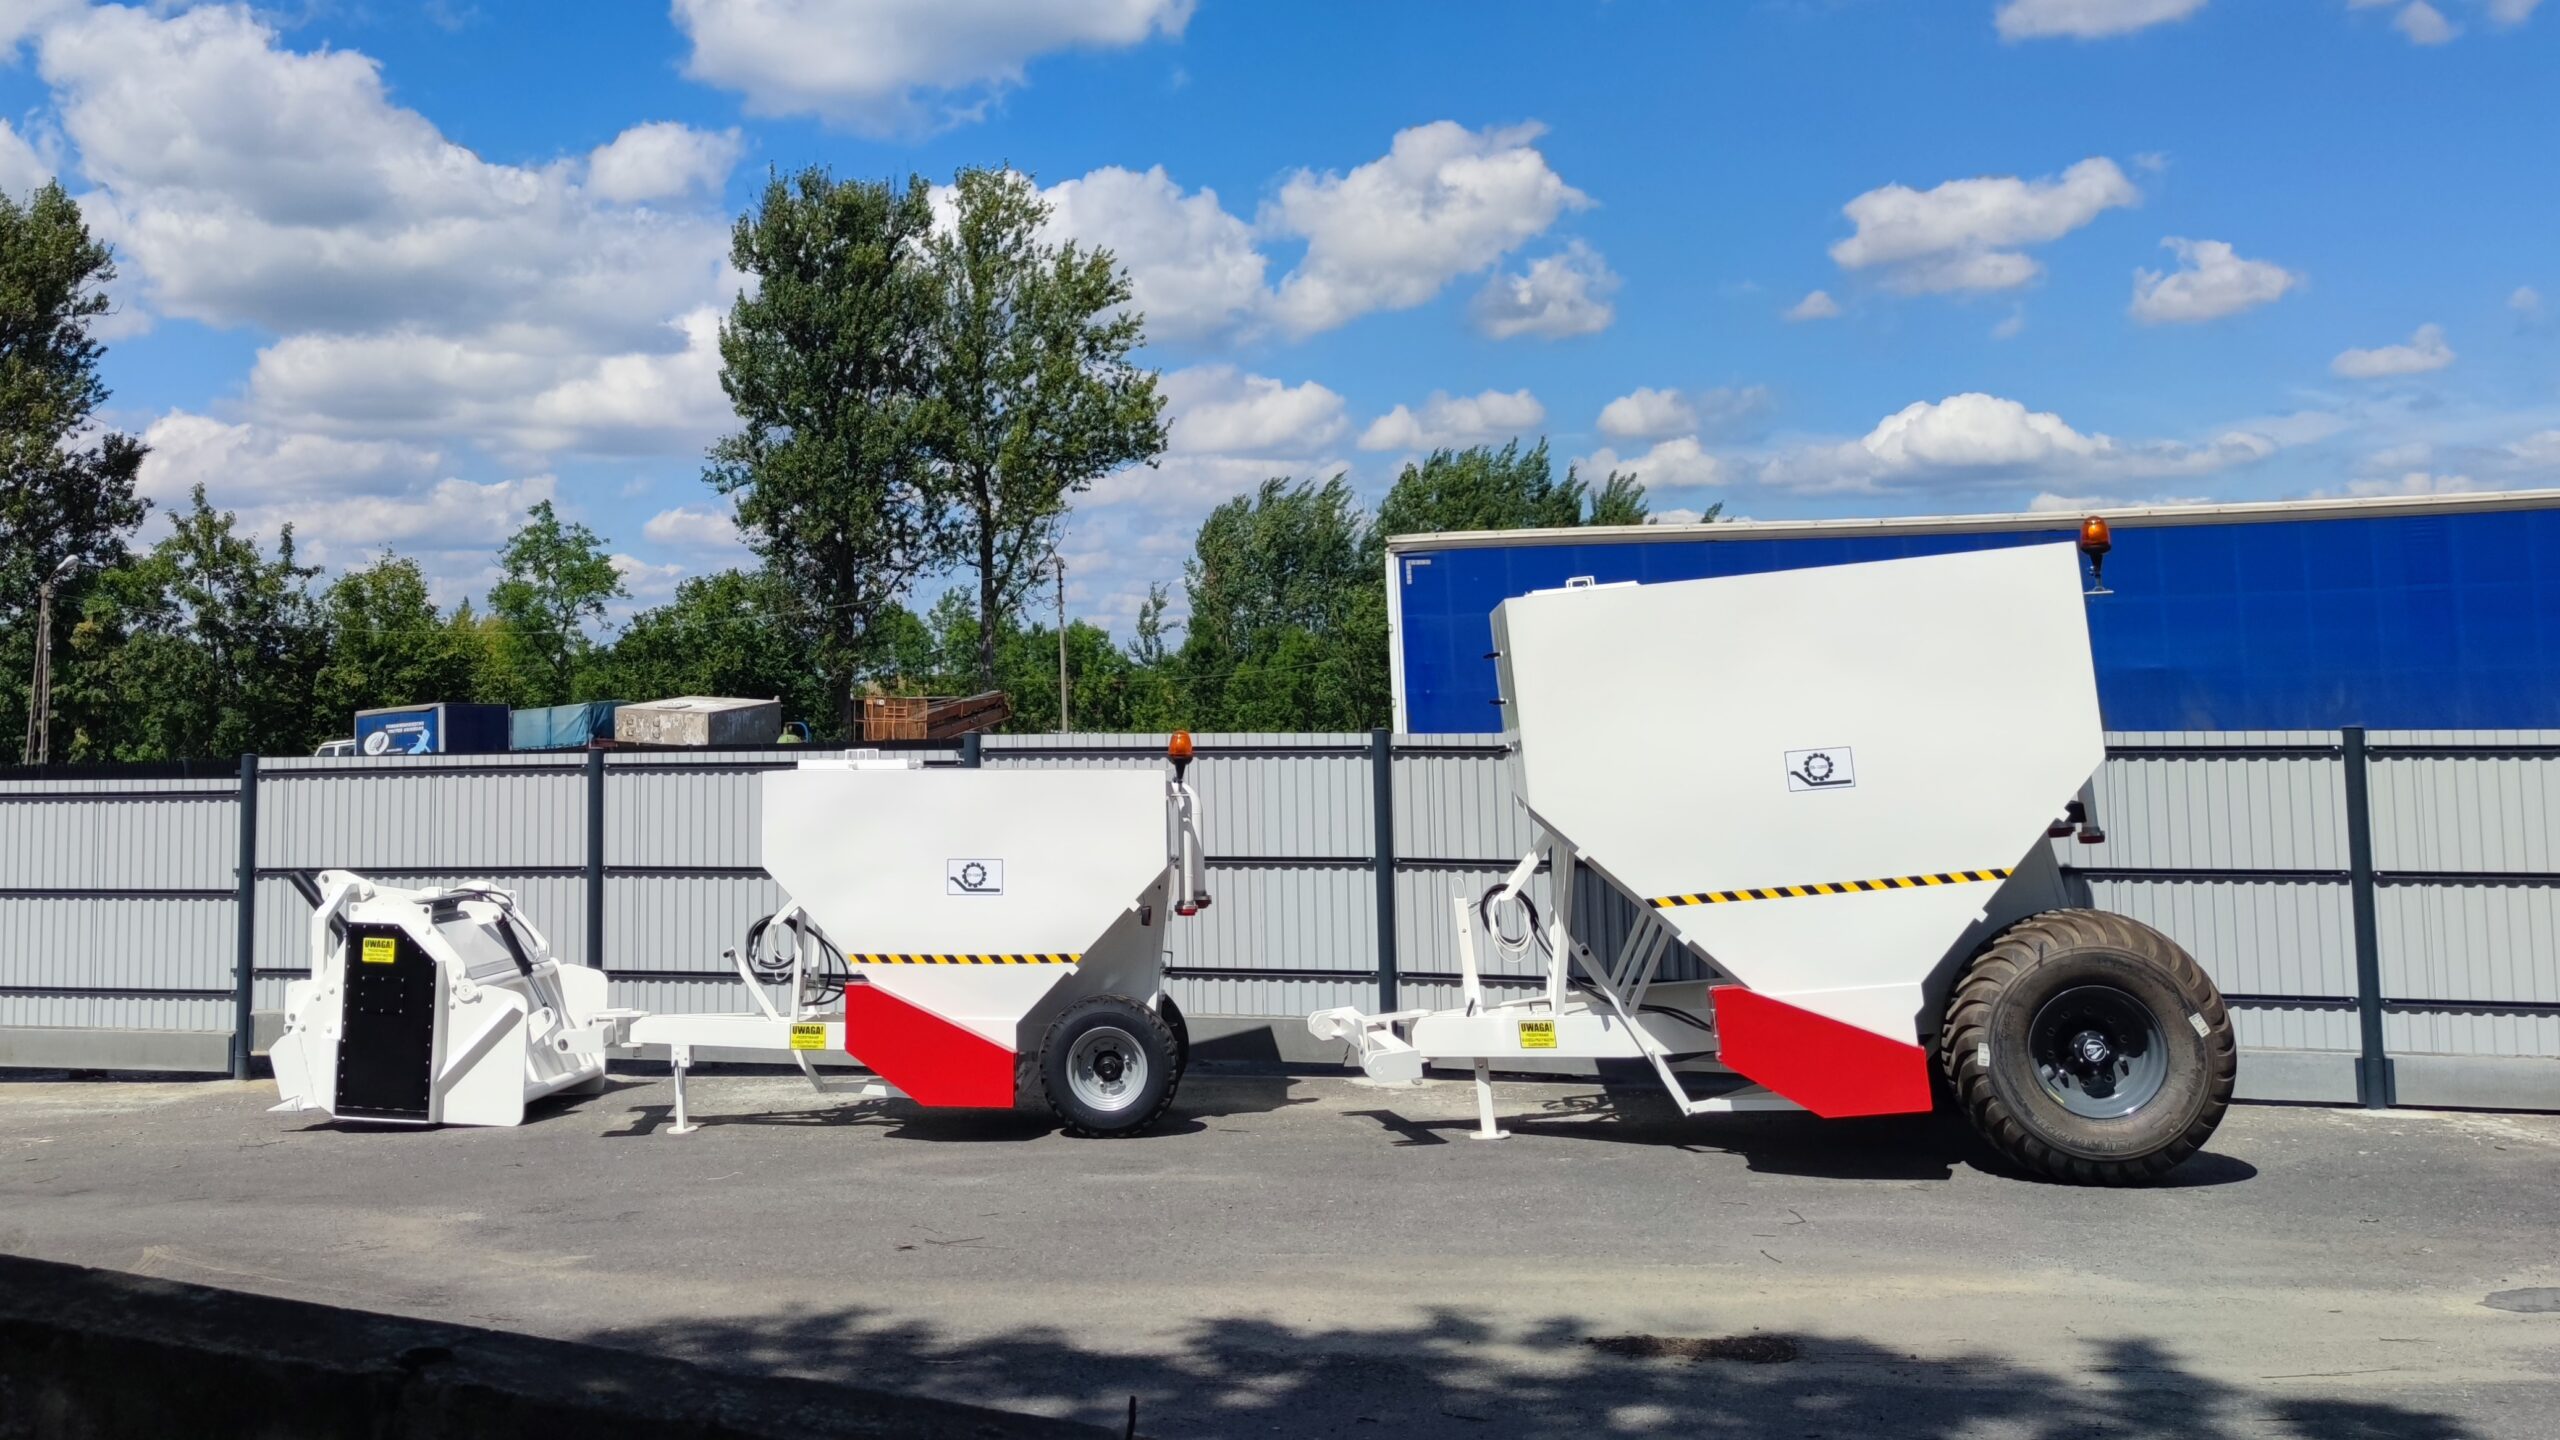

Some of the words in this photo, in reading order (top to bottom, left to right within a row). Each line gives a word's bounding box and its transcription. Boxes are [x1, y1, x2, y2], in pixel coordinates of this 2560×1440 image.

[365, 940, 393, 948] UWAGA!
[792, 1026, 823, 1034] UWAGA!
[1521, 1023, 1552, 1032] UWAGA!
